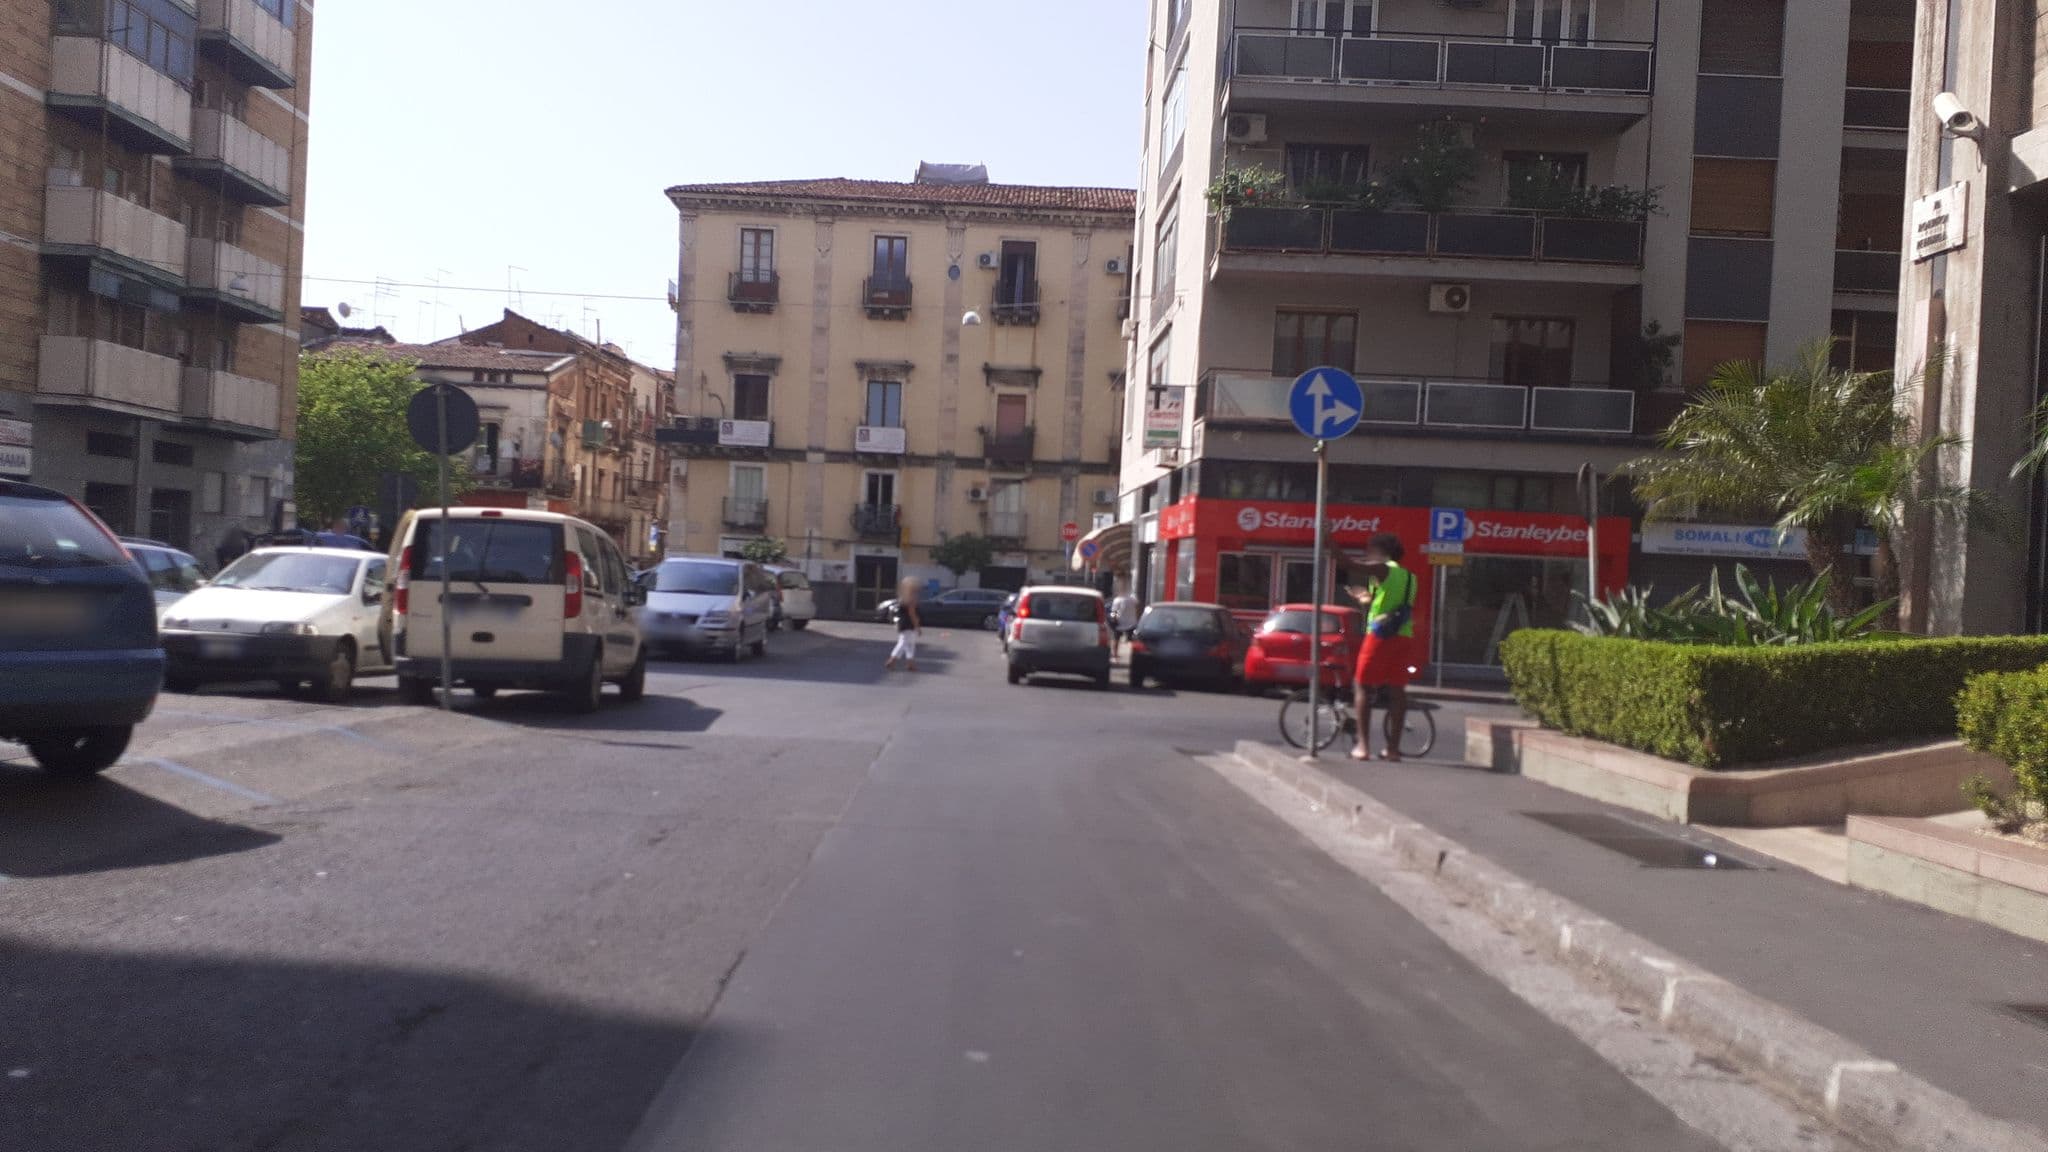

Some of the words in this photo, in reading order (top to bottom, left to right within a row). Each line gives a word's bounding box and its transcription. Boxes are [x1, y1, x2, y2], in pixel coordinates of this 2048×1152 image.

[1263, 511, 1381, 533] Stanybet
[1437, 511, 1460, 538] P
[1475, 521, 1590, 543] Stanleybe
